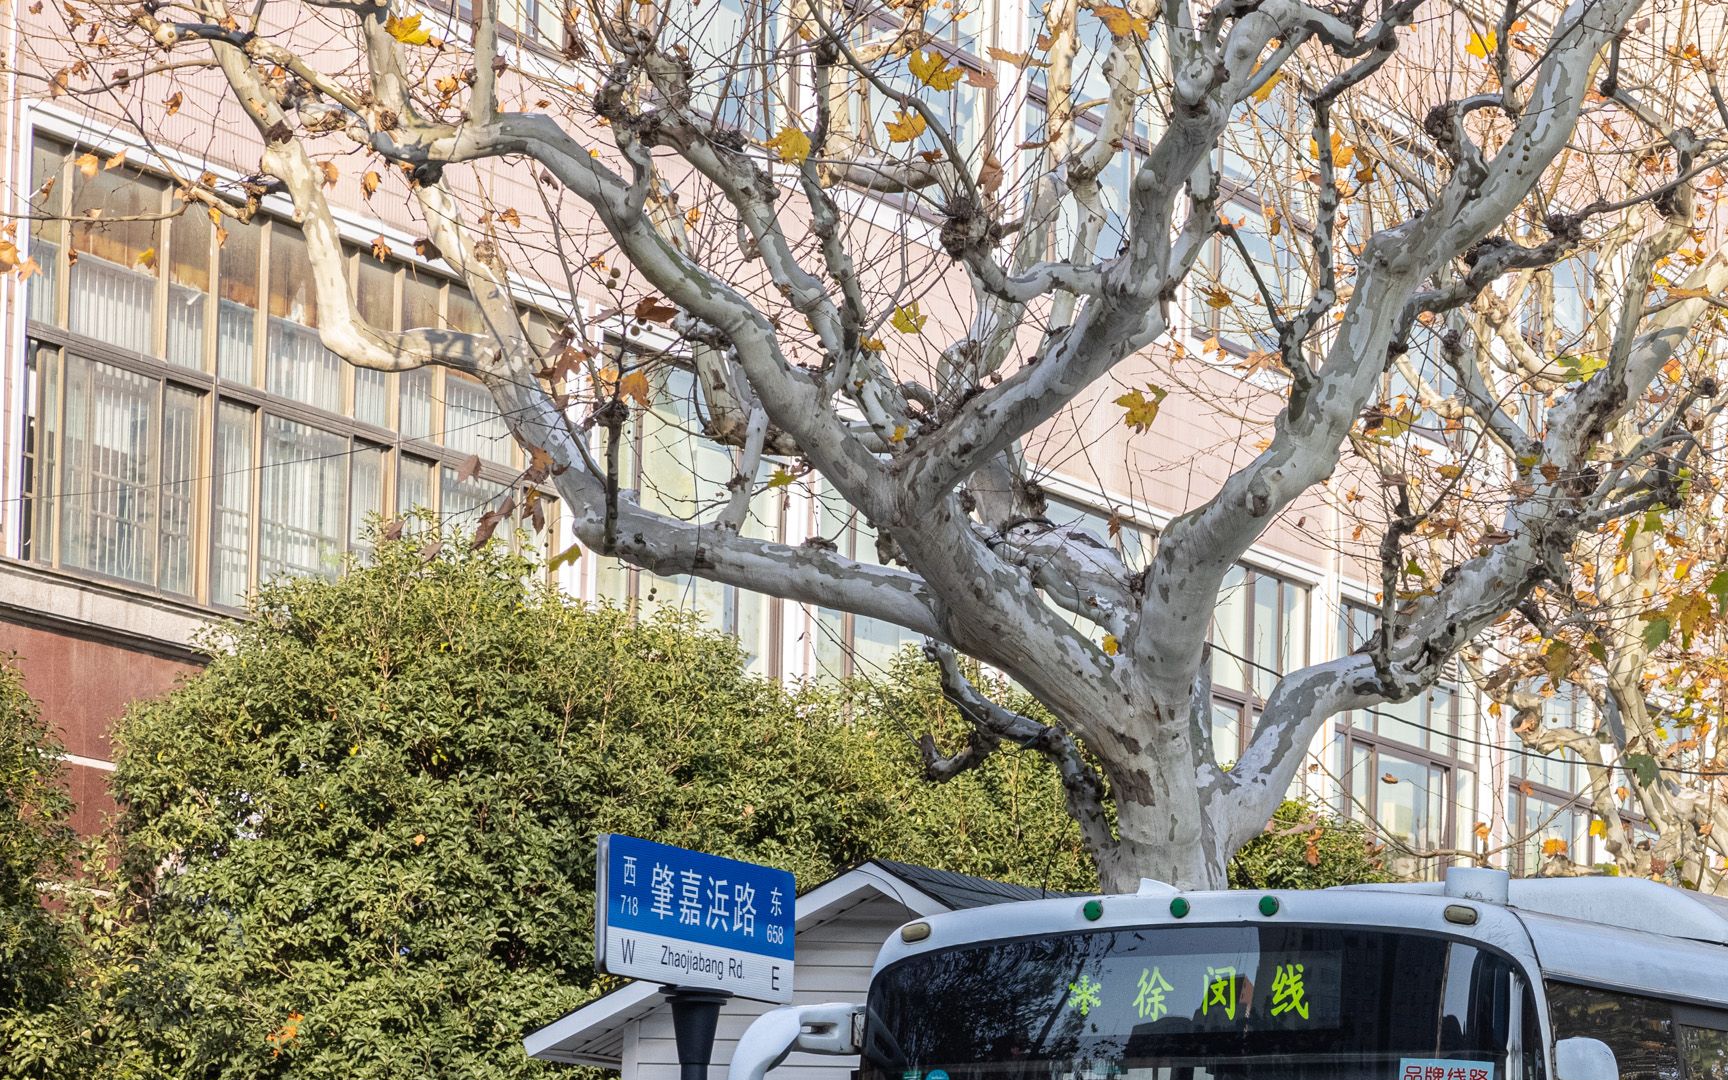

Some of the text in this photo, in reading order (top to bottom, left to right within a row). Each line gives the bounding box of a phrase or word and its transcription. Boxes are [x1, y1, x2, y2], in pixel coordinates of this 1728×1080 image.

[623, 855, 637, 887] 西
[620, 894, 639, 917] 718
[650, 862, 757, 938] 肇嘉浜路
[770, 887, 783, 917] 东
[766, 924, 784, 945] 658
[621, 937, 636, 965] W
[660, 945, 745, 981] Zhaojiabang Rd.
[771, 966, 780, 992] E
[1133, 964, 1309, 1022] 徐闵线
